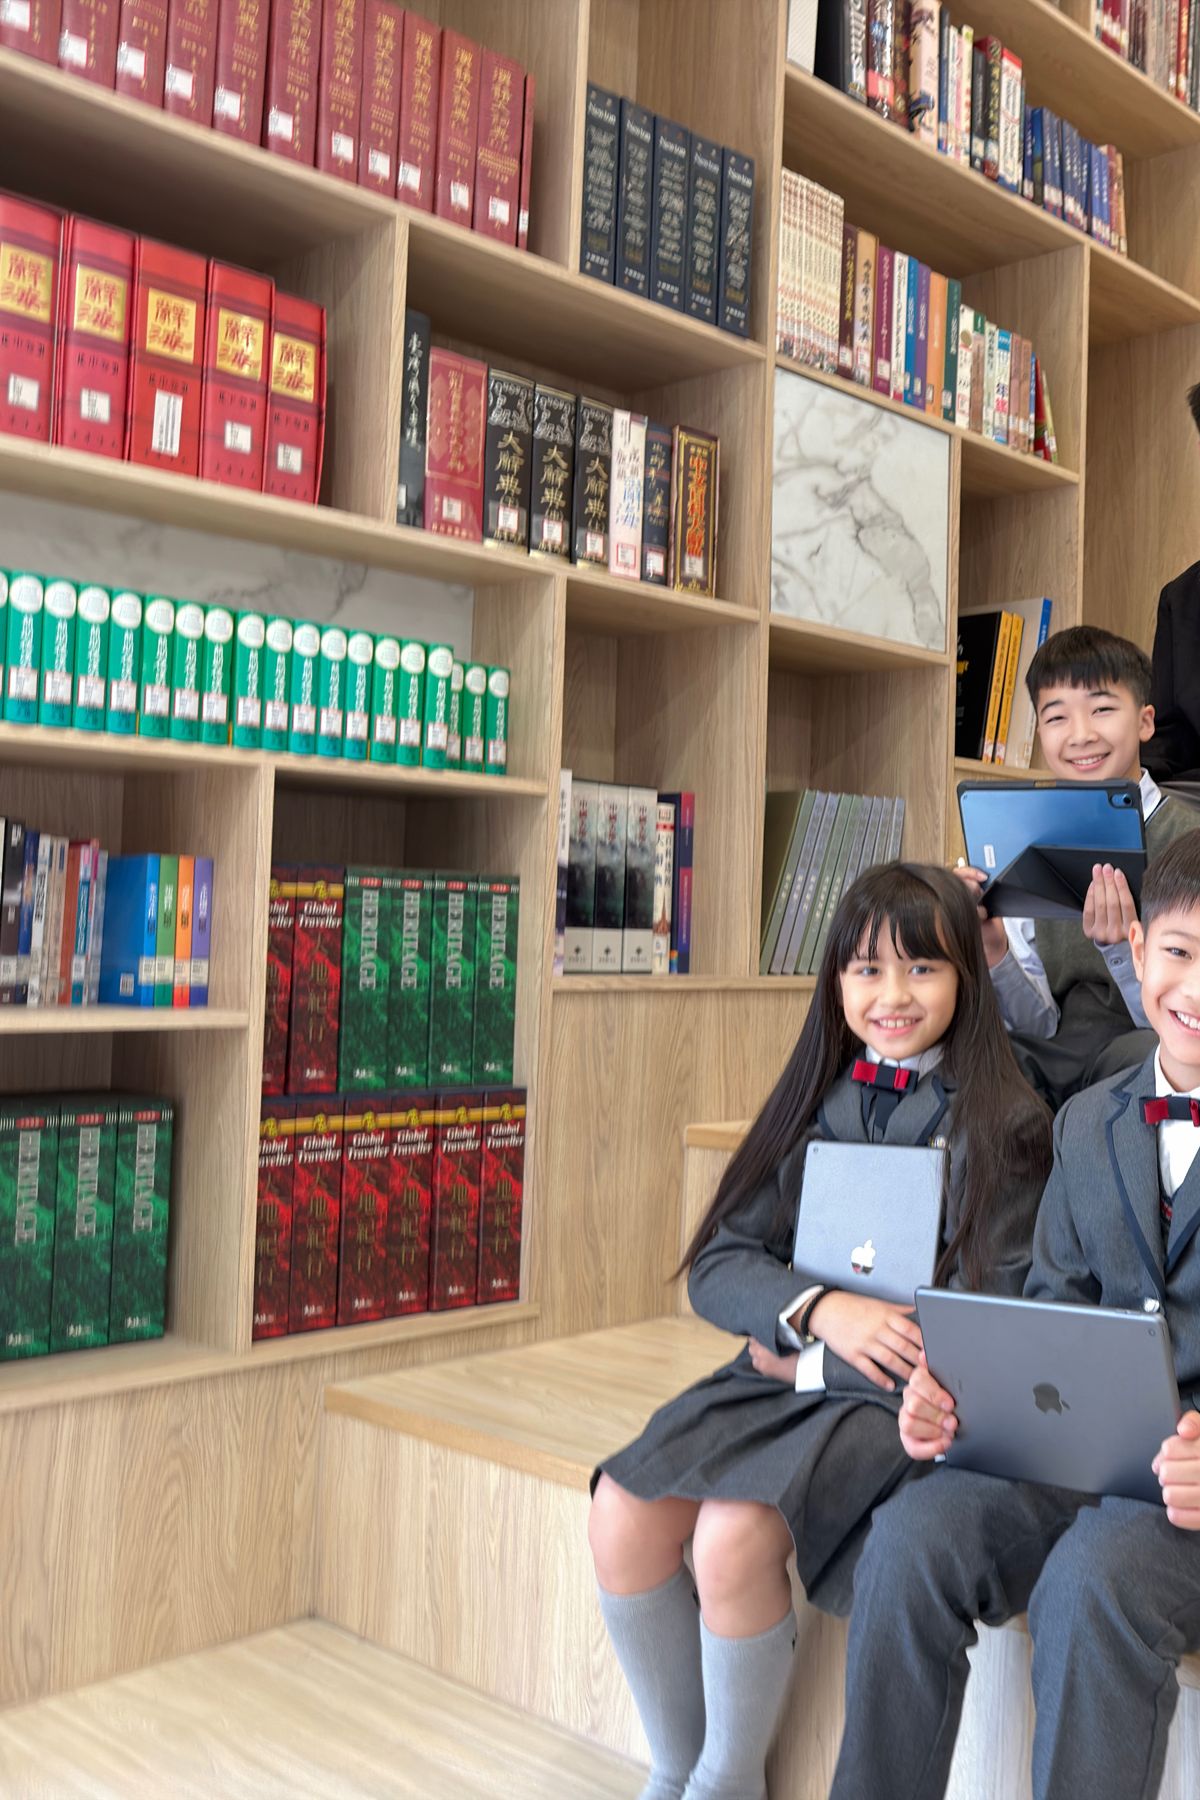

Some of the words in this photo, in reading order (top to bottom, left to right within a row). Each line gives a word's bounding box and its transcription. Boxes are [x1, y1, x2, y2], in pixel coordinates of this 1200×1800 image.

[304, 901, 337, 916] Global
[299, 916, 341, 929] Traveller
[359, 890, 379, 990] HERITAGE
[401, 892, 420, 990] HERITAGE
[446, 893, 464, 990] HERITAGE
[490, 895, 507, 990] HERITAGE
[397, 1128, 428, 1143] Global
[446, 1124, 476, 1139] Global
[491, 1122, 521, 1136] Global
[303, 1134, 337, 1150] Global
[352, 1130, 385, 1146] Global
[442, 1138, 481, 1152] Traveller
[486, 1134, 525, 1148] Traveller
[259, 1139, 288, 1153] lobal
[347, 1145, 390, 1160] Traveller
[391, 1141, 433, 1156] Traveller
[297, 1148, 341, 1164] Traveller
